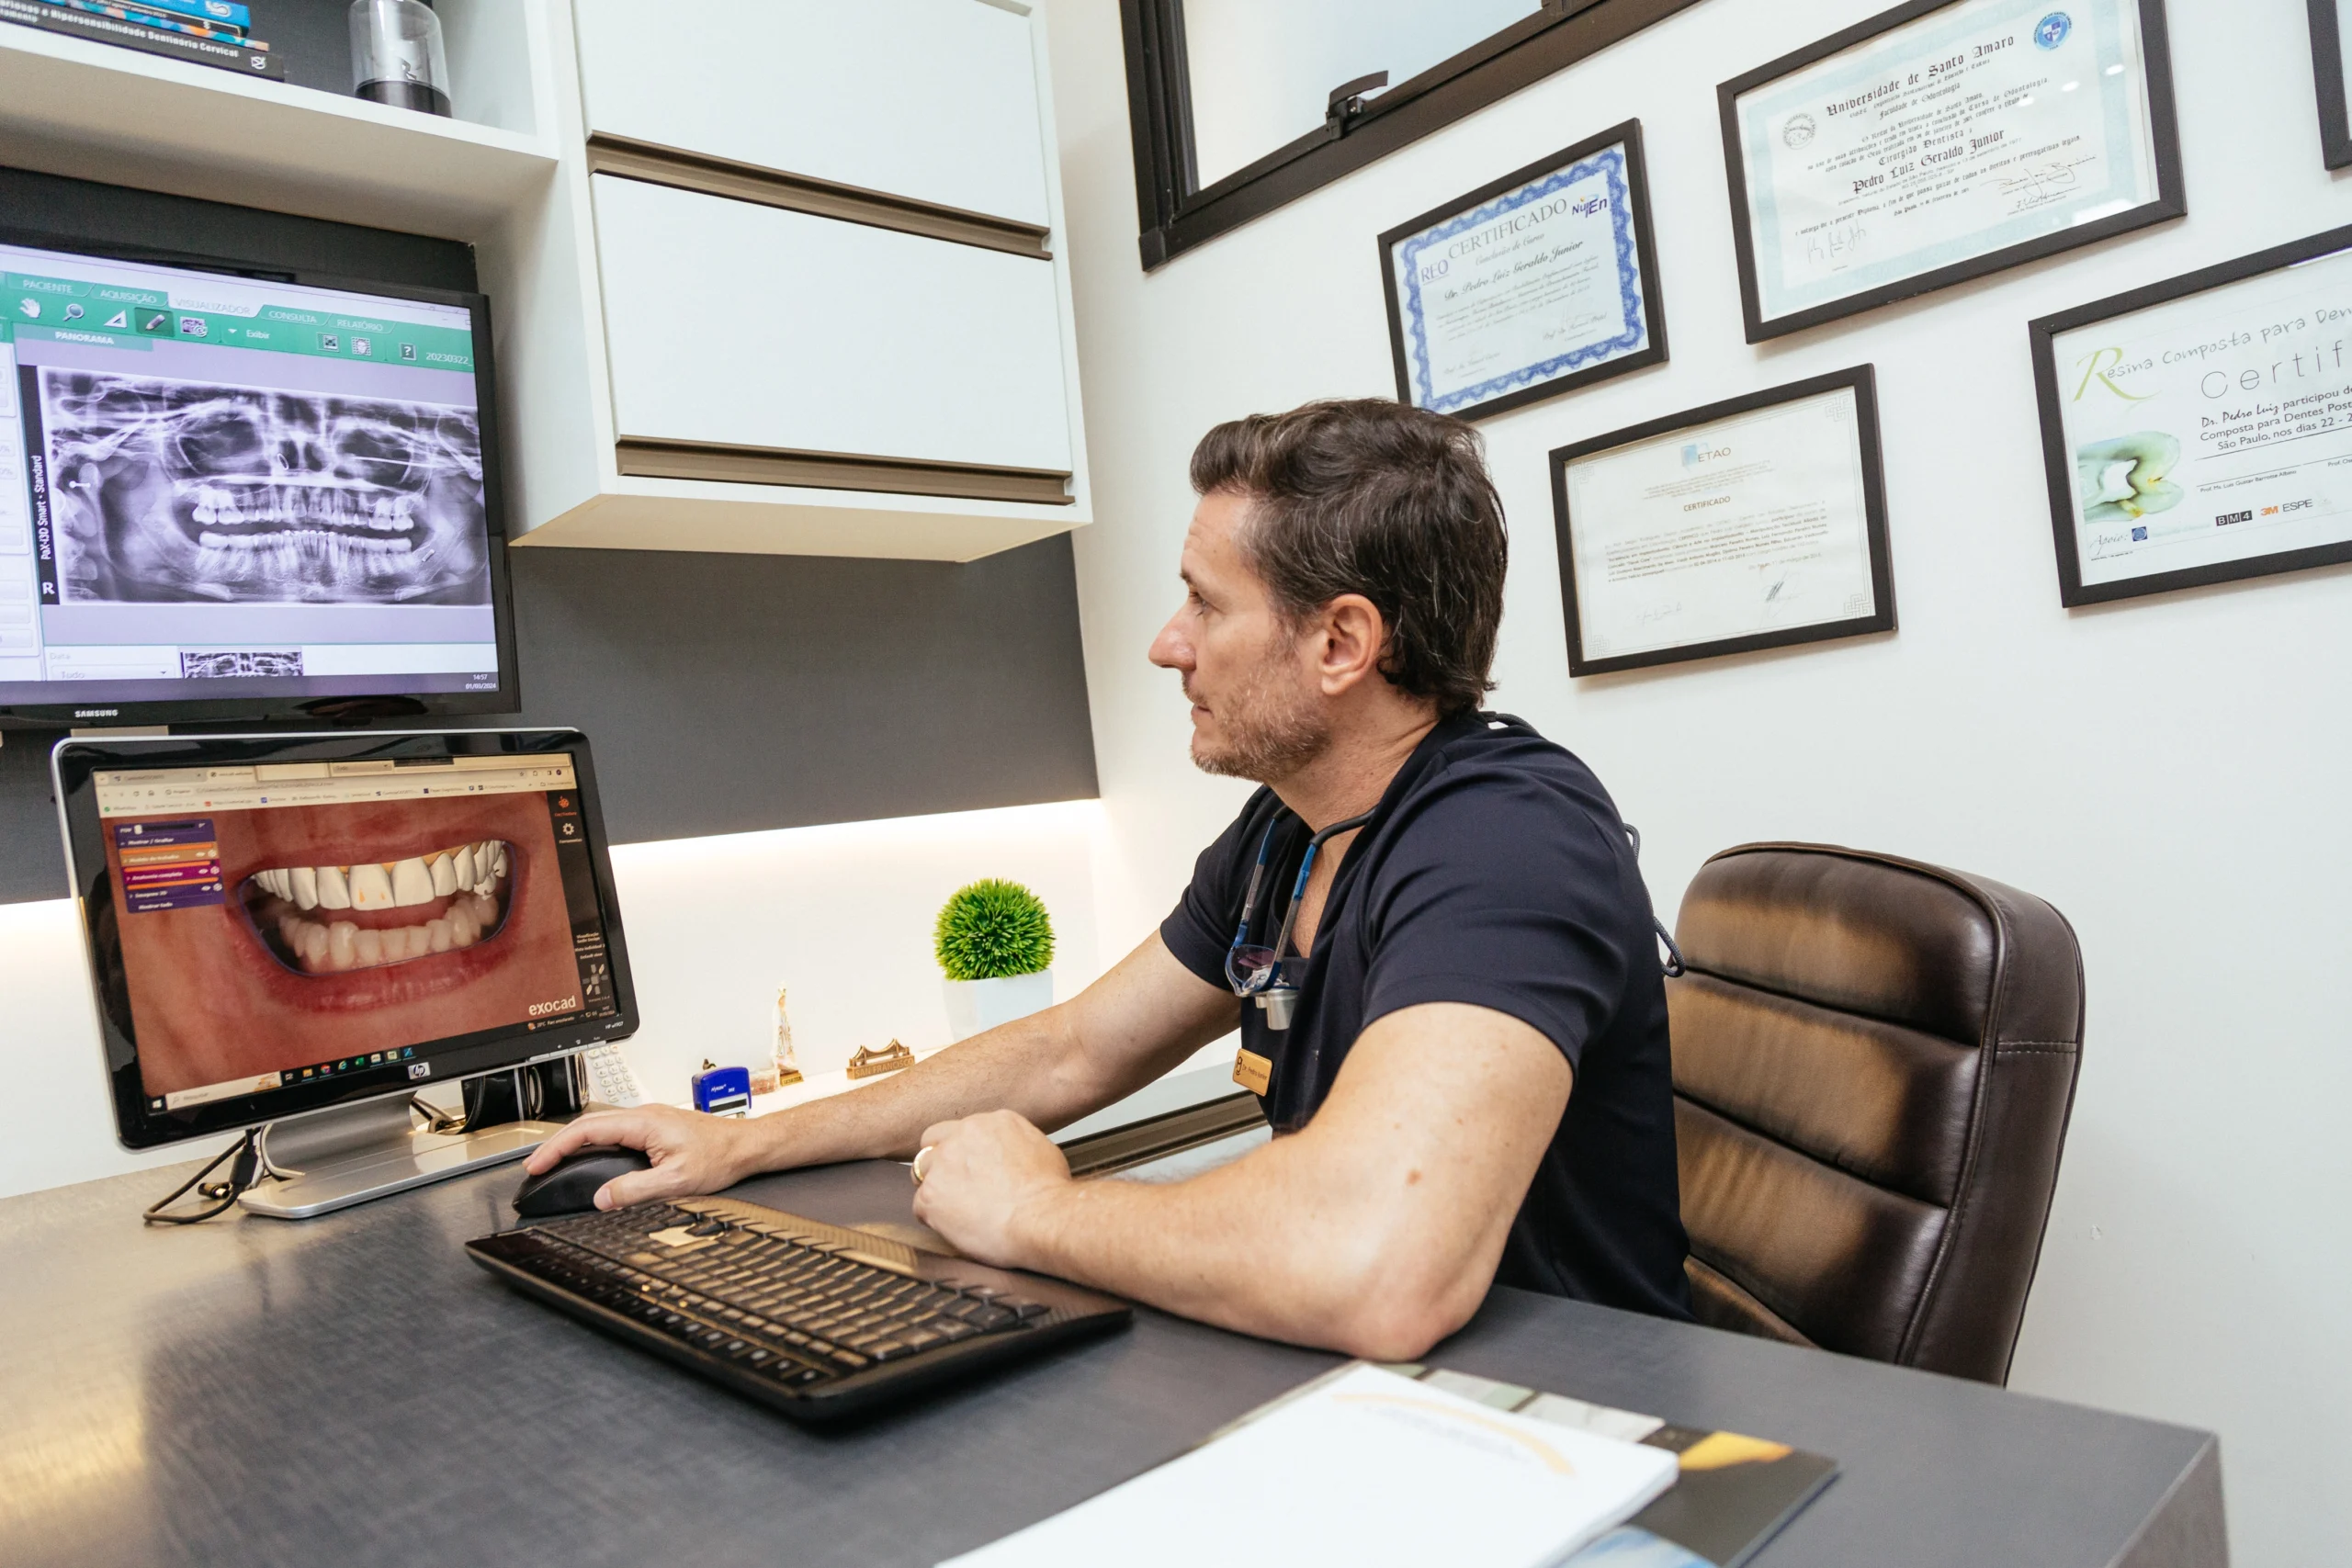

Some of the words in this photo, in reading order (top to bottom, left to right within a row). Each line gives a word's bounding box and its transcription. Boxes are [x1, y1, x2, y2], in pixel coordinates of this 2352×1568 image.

[41, 8, 49, 17] e
[51, 9, 146, 38] Hipersensibilidade
[148, 31, 198, 49] Dentinária
[200, 43, 239, 58] Cervical
[1826, 81, 1899, 116] Universidade
[1907, 73, 1919, 85] de
[1928, 54, 1964, 77] Santo
[1974, 36, 2014, 58] Amaro
[1921, 83, 1961, 102] Odontologia
[1968, 99, 1989, 111] Curso
[1852, 175, 1884, 194] Pedro
[1890, 162, 1915, 179] Luiz
[1920, 146, 1963, 166] Geraldo
[1970, 130, 2004, 154] Junior
[1878, 145, 1917, 165] Cirurgião
[1923, 130, 1963, 149] Dentista
[1448, 198, 1566, 259] CERTIFICADO
[1420, 259, 1449, 282] REO
[1462, 277, 1488, 294] Pedro
[1513, 252, 1548, 273] Geraldo
[1549, 241, 1583, 263] Junior
[23, 279, 73, 294] PACIENTE
[100, 289, 156, 305] AQUISIÇÃO
[175, 298, 251, 315] VISUALIZADOR
[268, 310, 317, 323] CONSULTA
[337, 319, 383, 332] RELATÓRIO
[55, 331, 114, 344] PANORAMA
[246, 329, 270, 340] Exibir
[2073, 347, 2160, 401] Resina
[2162, 332, 2251, 365] Composta
[2260, 318, 2306, 344] para
[2201, 340, 2343, 399] Certif
[2201, 417, 2218, 428] Dr.
[2222, 410, 2253, 423] Pedro
[2256, 403, 2279, 416] Luiz
[2283, 389, 2339, 411] participou
[2343, 385, 2352, 395] d
[2200, 423, 2254, 441] Composta
[2257, 419, 2280, 431] para
[2284, 408, 2324, 423] Dentes
[2218, 439, 2236, 450] São
[2240, 433, 2271, 446] Paulo,
[2273, 428, 2292, 438] nos
[2296, 422, 2317, 433] dias
[2321, 416, 2335, 428] 22
[31, 455, 45, 492] Standard
[38, 498, 48, 526] Smart
[1683, 495, 1731, 512] CERTIFICADO
[2260, 506, 2278, 516] 3M
[2282, 499, 2312, 513] ESPE
[43, 581, 55, 594] R
[74, 709, 119, 718] SAMSUNG
[528, 995, 576, 1016] exocad
[854, 1066, 872, 1077] SAN
[872, 1057, 913, 1074] FRANCISCO
